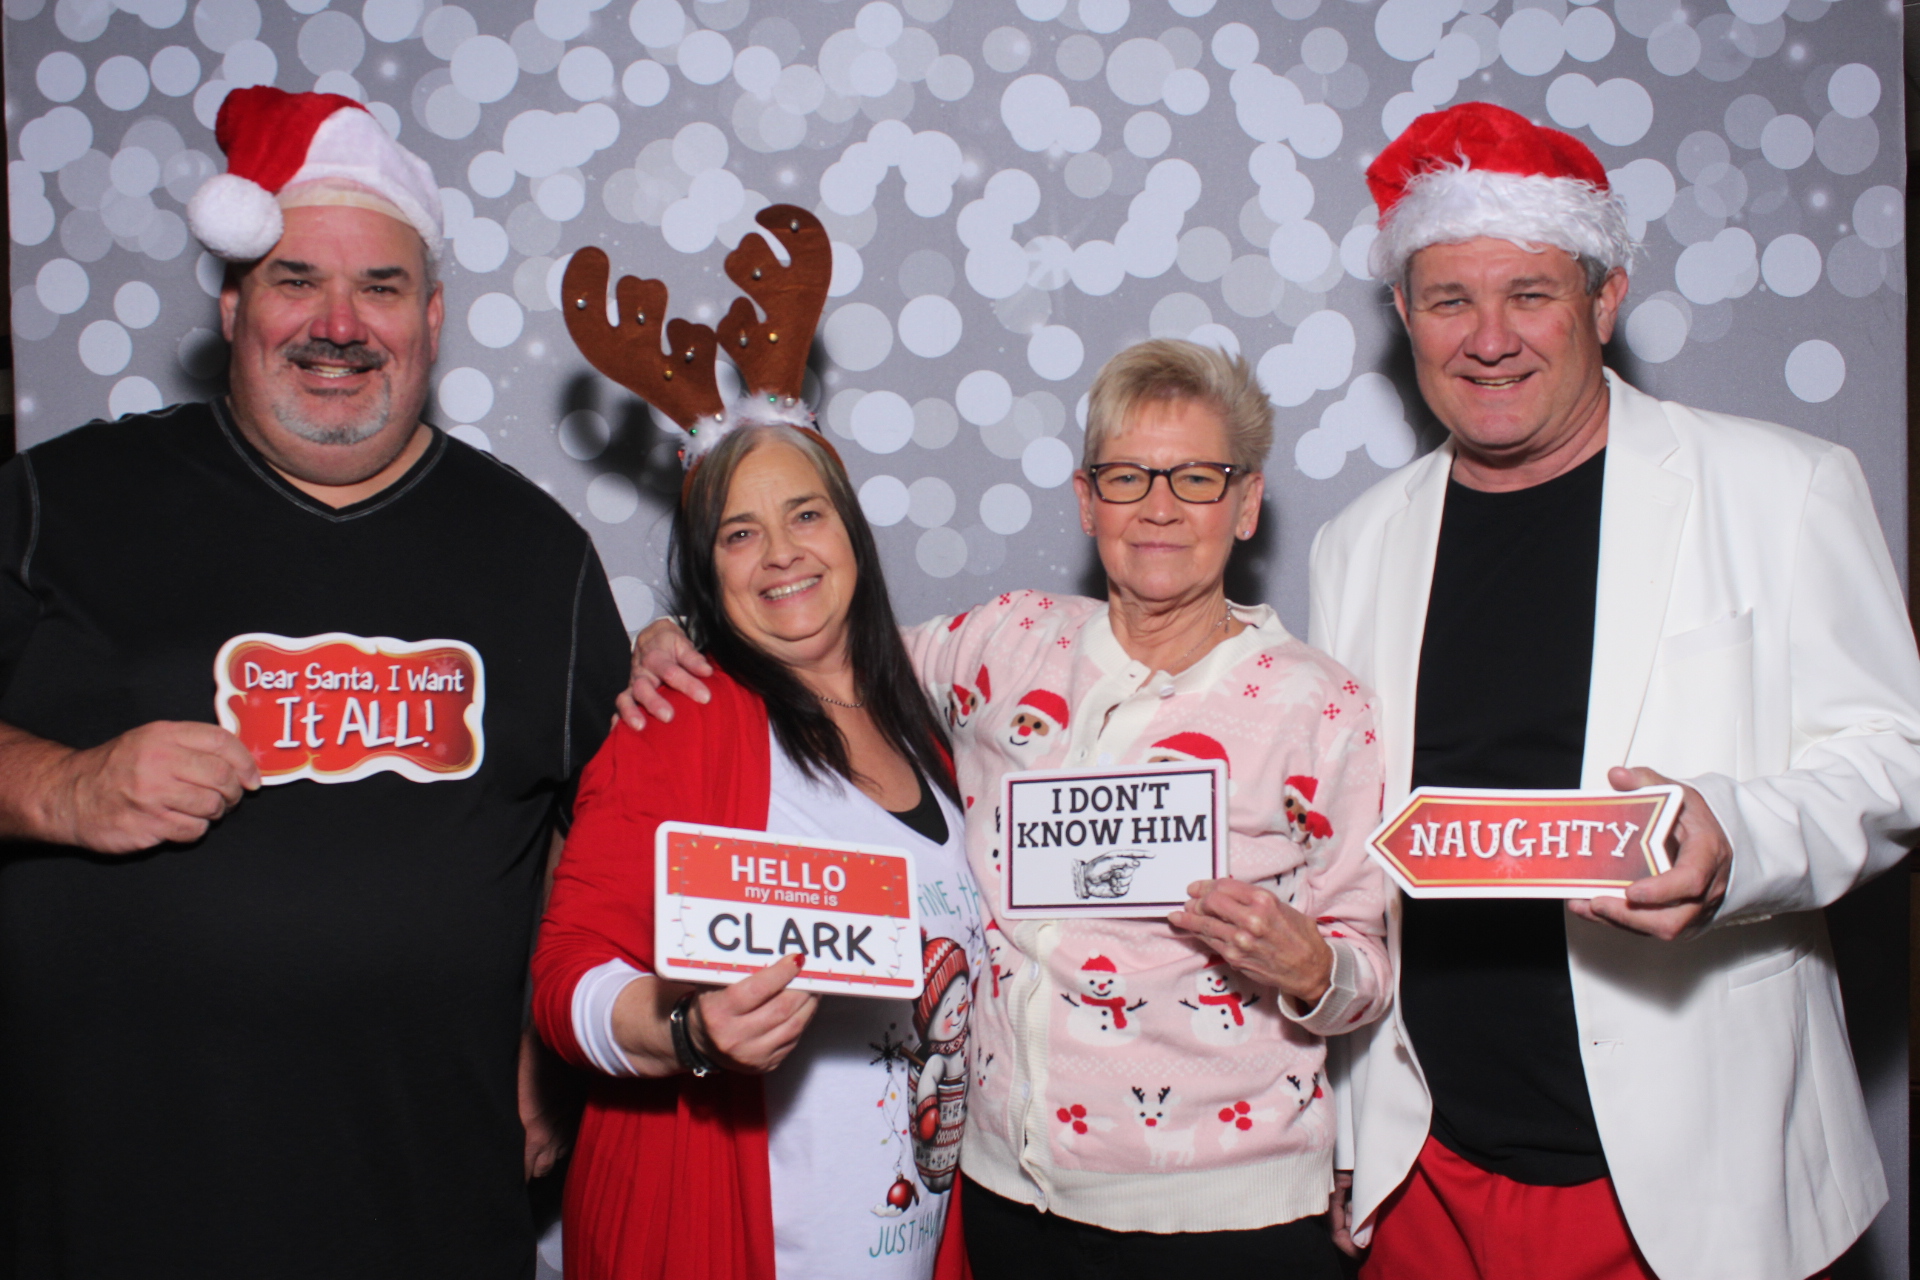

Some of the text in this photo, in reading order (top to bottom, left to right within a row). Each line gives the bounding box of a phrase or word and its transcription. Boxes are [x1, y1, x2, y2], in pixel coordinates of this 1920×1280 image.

[244, 661, 465, 693] Dear Santa, I Want
[273, 696, 434, 748] It ALL!
[1052, 782, 1170, 814] I DON'T
[1017, 814, 1207, 848] KNOW HIM
[1409, 818, 1640, 858] NAUGHTY
[731, 854, 846, 892] HELLO
[745, 885, 838, 907] my name is
[708, 912, 875, 966] CLARK
[869, 1219, 916, 1258] JUST
